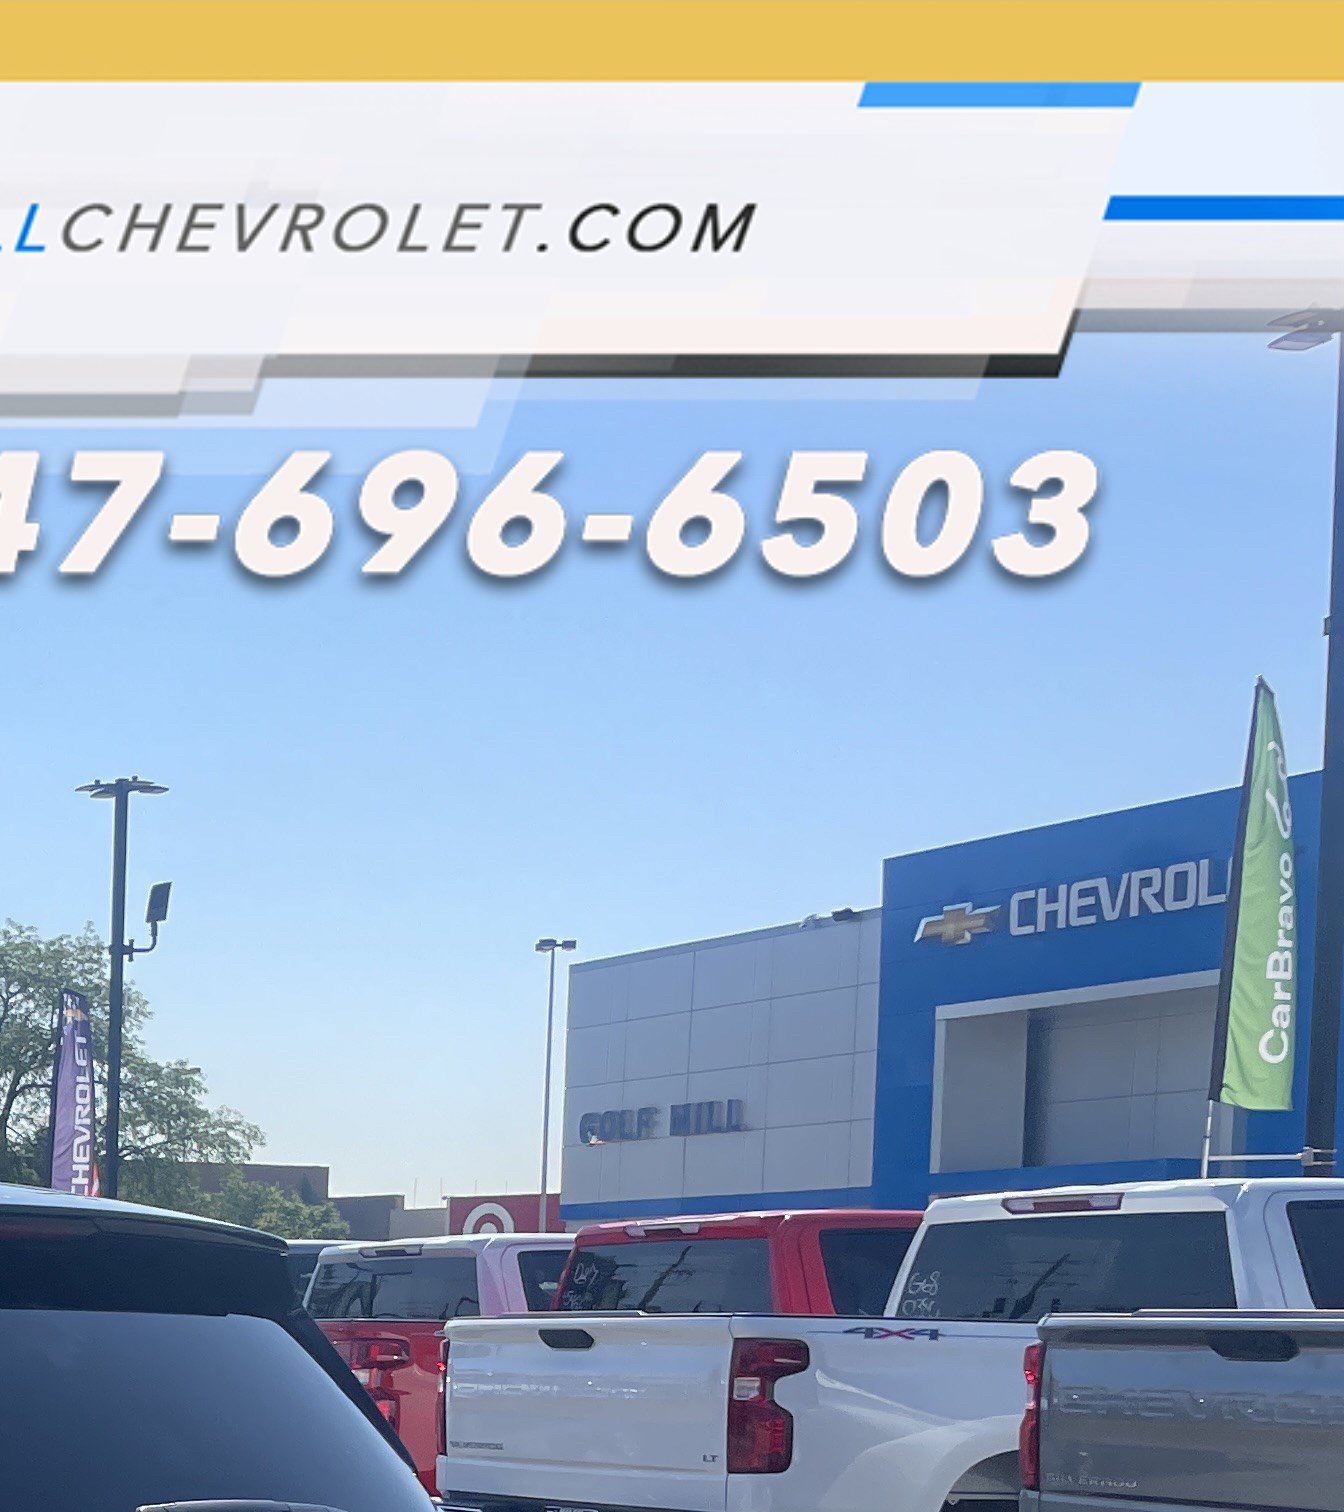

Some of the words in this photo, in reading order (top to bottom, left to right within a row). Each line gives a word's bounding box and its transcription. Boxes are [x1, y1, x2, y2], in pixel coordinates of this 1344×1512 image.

[1009, 857, 1233, 936] CHEVROL
[1258, 852, 1294, 1064] CarBravo
[580, 1107, 658, 1143] GOLF
[670, 1099, 746, 1136] MILL
